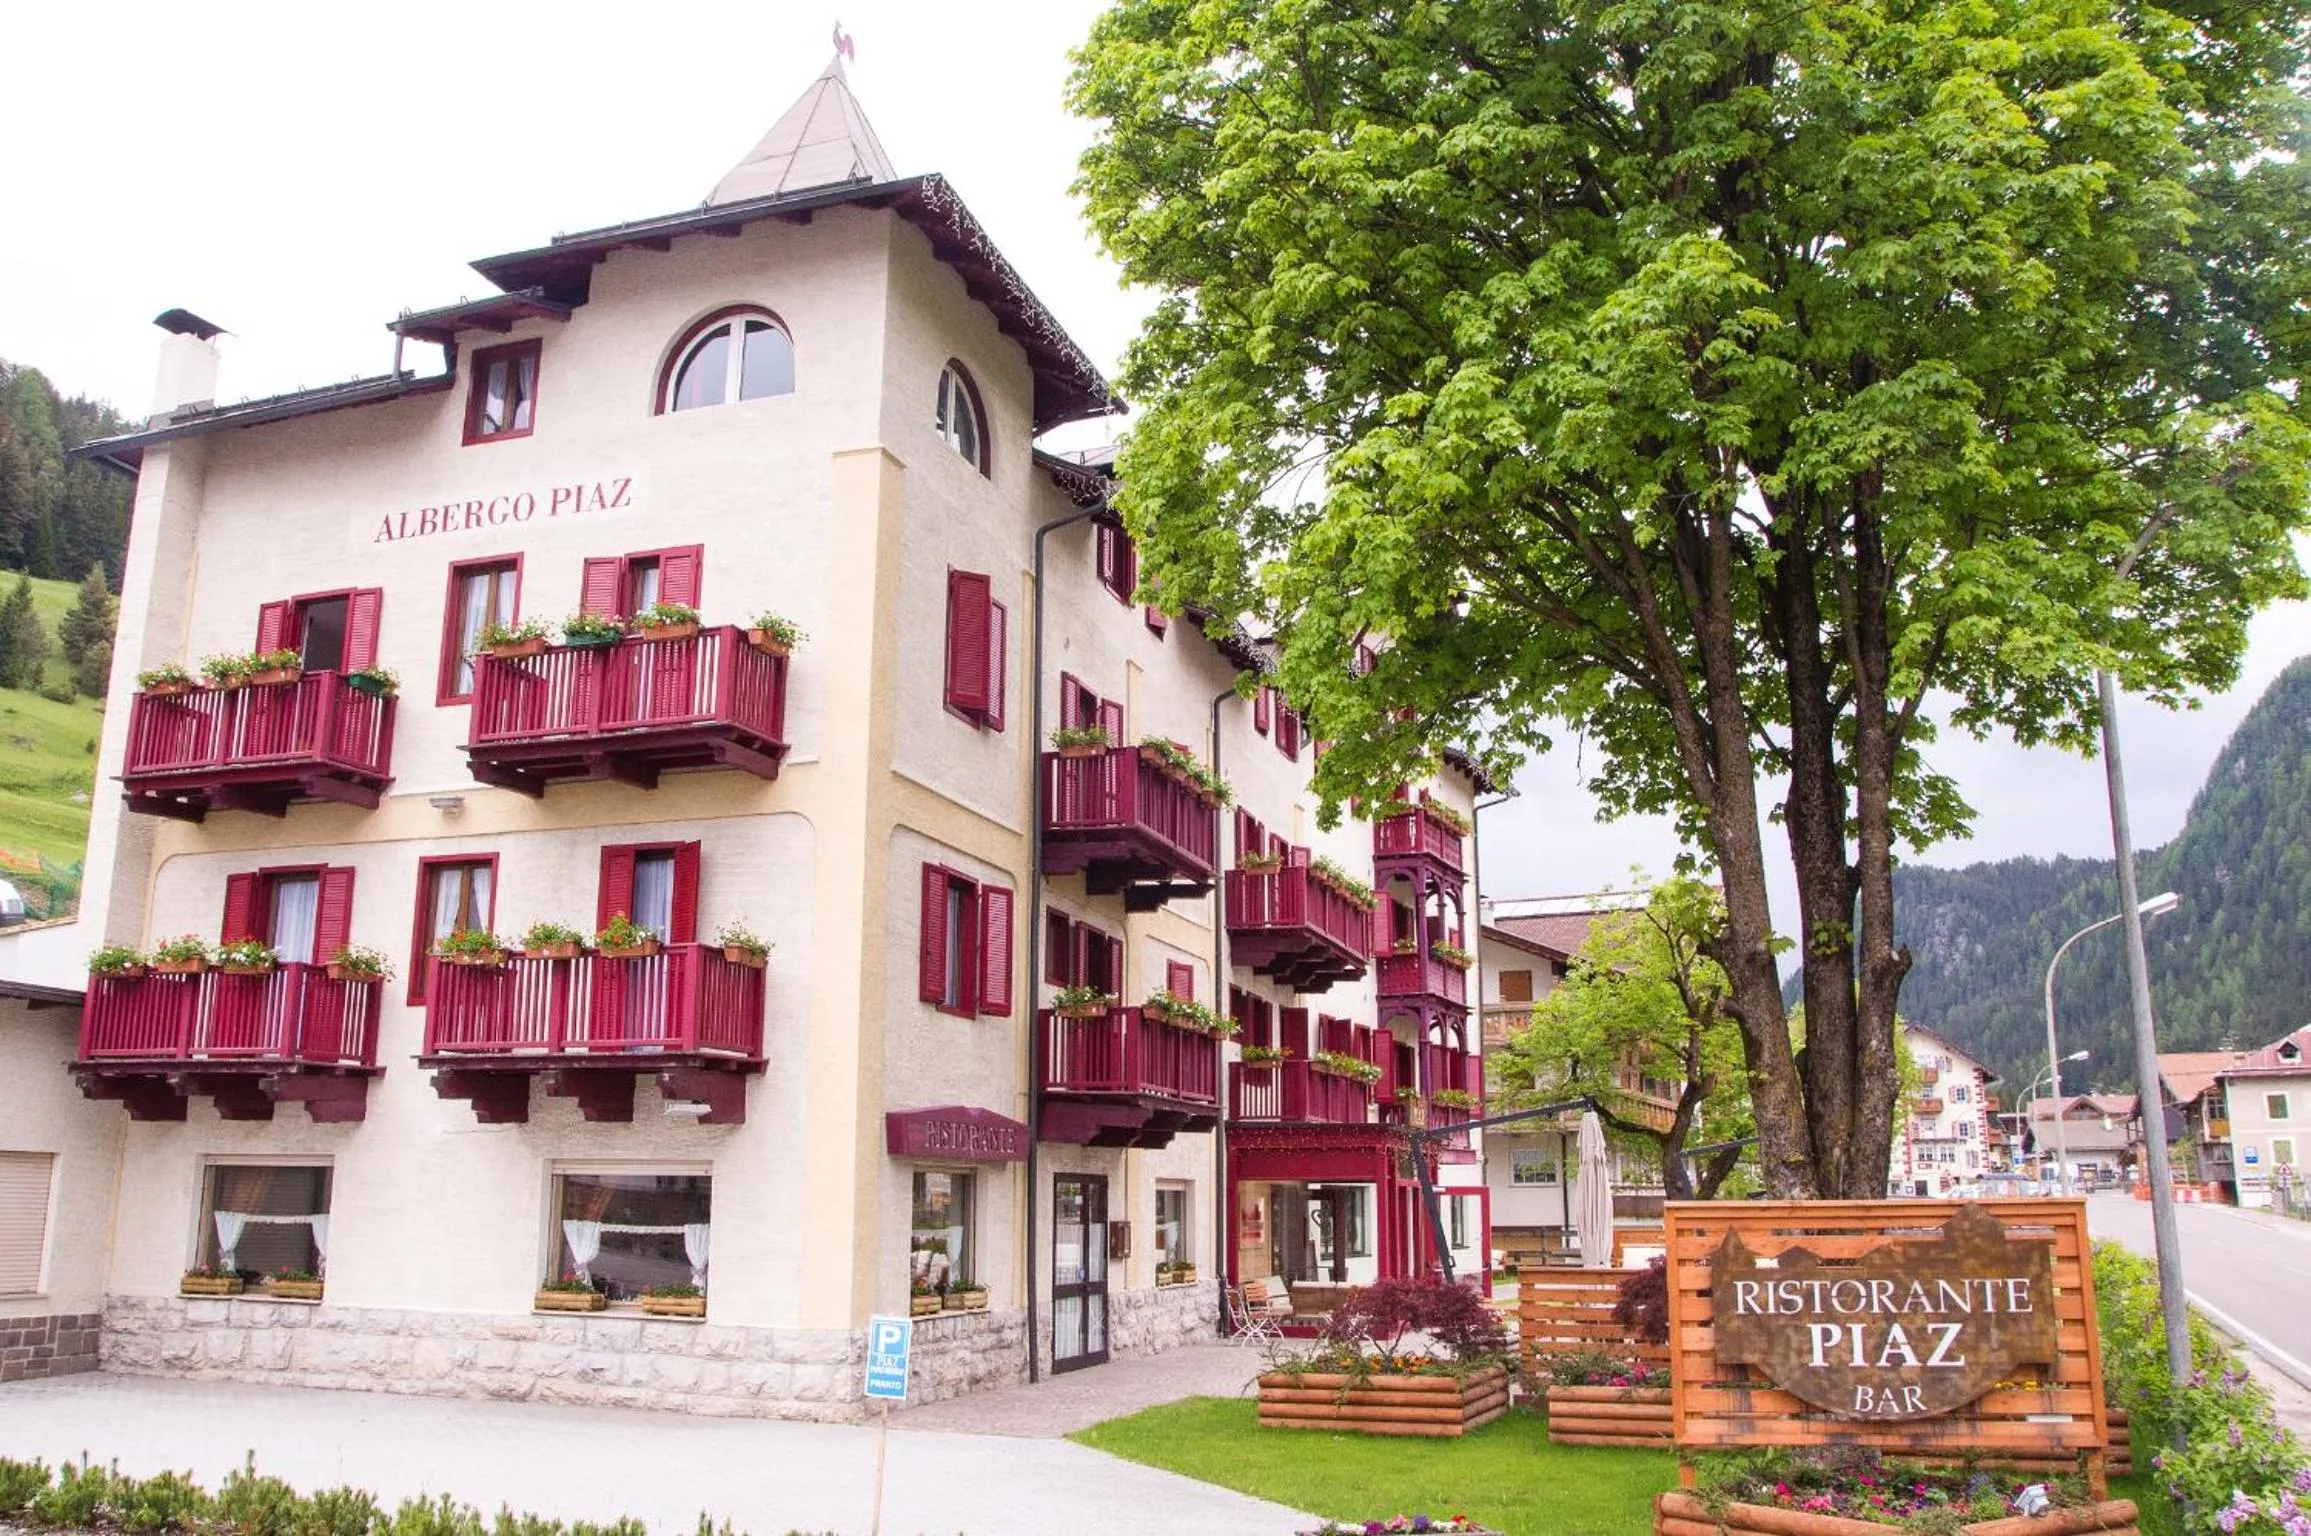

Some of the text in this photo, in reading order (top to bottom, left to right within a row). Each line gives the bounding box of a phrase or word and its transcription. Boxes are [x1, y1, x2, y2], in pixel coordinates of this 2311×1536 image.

[373, 478, 632, 543] ALBERGO PIAZ
[924, 1120, 1016, 1153] RISTORANTE
[1733, 1278, 2033, 1316] RISTORANTE
[878, 1324, 902, 1353] P
[1807, 1322, 1965, 1368] PIAZ
[1853, 1384, 1929, 1414] BAR
